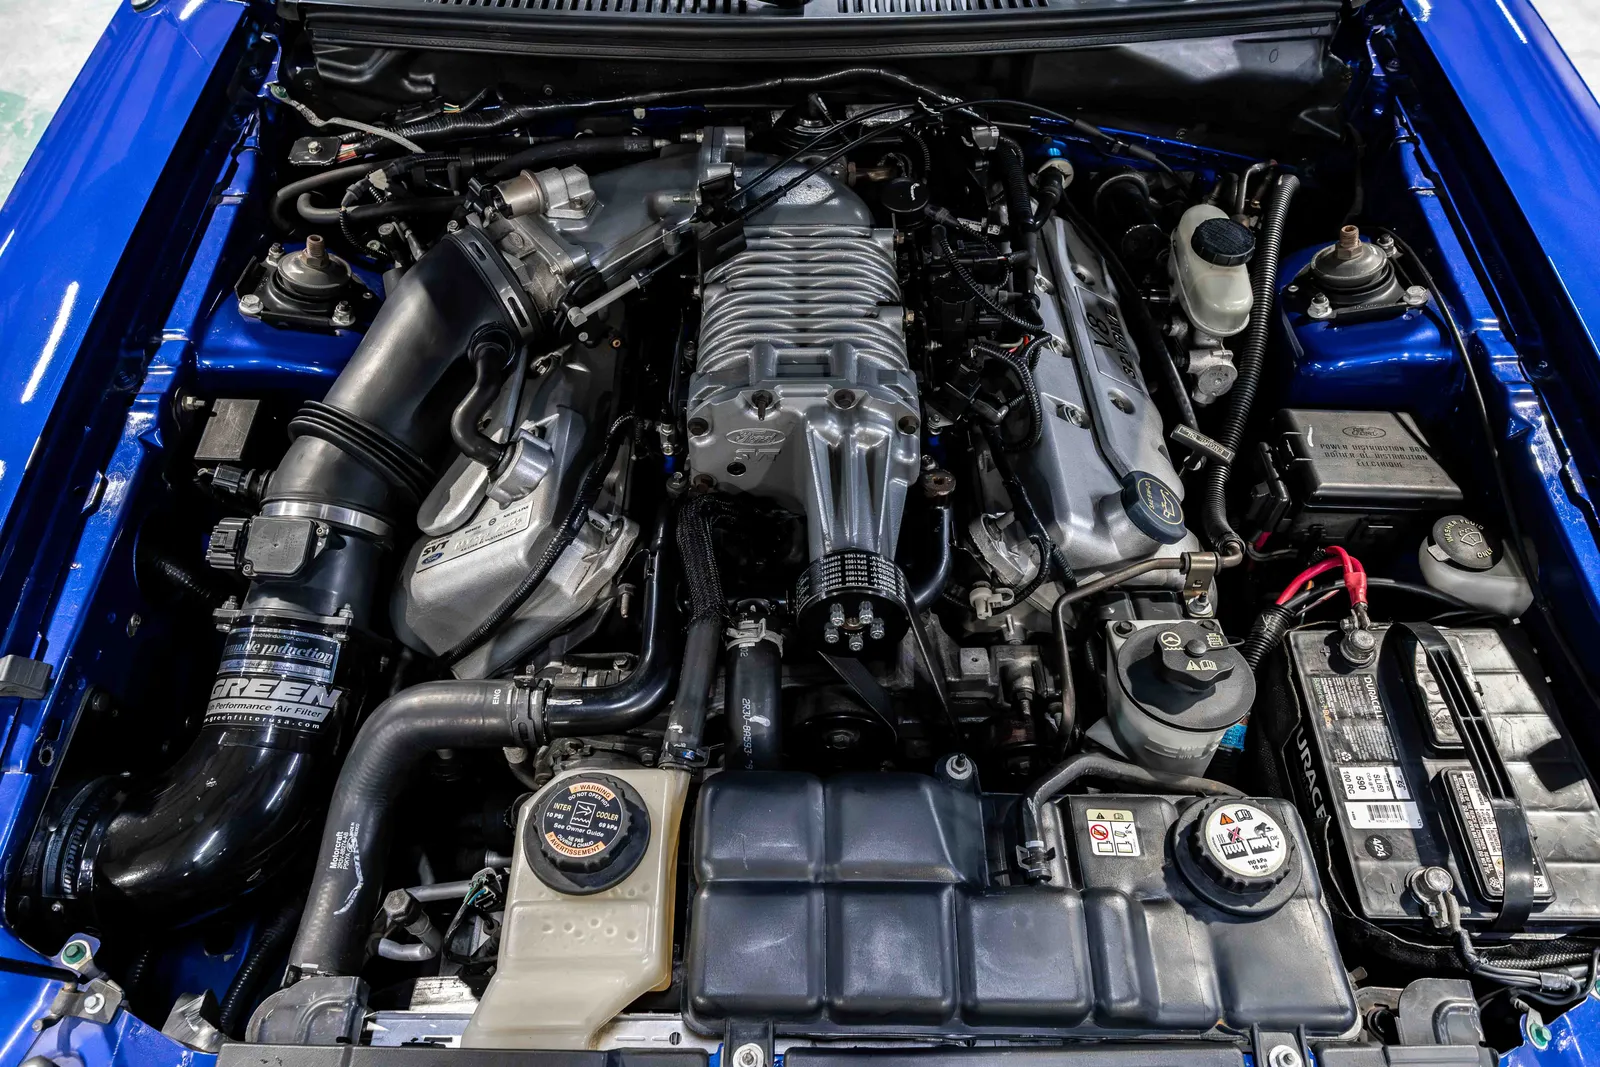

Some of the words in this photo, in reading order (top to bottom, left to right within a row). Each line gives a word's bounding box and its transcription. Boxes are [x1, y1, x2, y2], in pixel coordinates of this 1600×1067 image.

[1086, 311, 1114, 349] V8
[732, 429, 781, 444] Ford
[1352, 444, 1405, 452] DISTRIBUTION
[1375, 452, 1428, 460] DISTRIBUTION
[422, 540, 450, 557] SVT
[1477, 548, 1493, 558] ONLY
[210, 678, 342, 708] GREEN
[492, 688, 502, 705] ENG
[1364, 675, 1384, 720] DURACELL
[215, 702, 272, 712] Performance
[276, 704, 292, 713] Air
[294, 708, 322, 719] Filter
[1297, 726, 1328, 818] URACE
[1342, 771, 1351, 782] 100
[1345, 783, 1355, 794] RC
[1354, 775, 1367, 790] 590
[1372, 774, 1385, 792] SLI59
[580, 785, 611, 798] WARNING
[588, 792, 601, 800] OPEN
[553, 802, 572, 812] INTER
[596, 811, 619, 821] COOLER
[566, 824, 585, 833] Owner
[586, 829, 604, 838] Guide
[329, 831, 344, 869] Motorcraft
[551, 839, 601, 855] AVERTISSEMENT
[1373, 838, 1386, 857] 4/24
